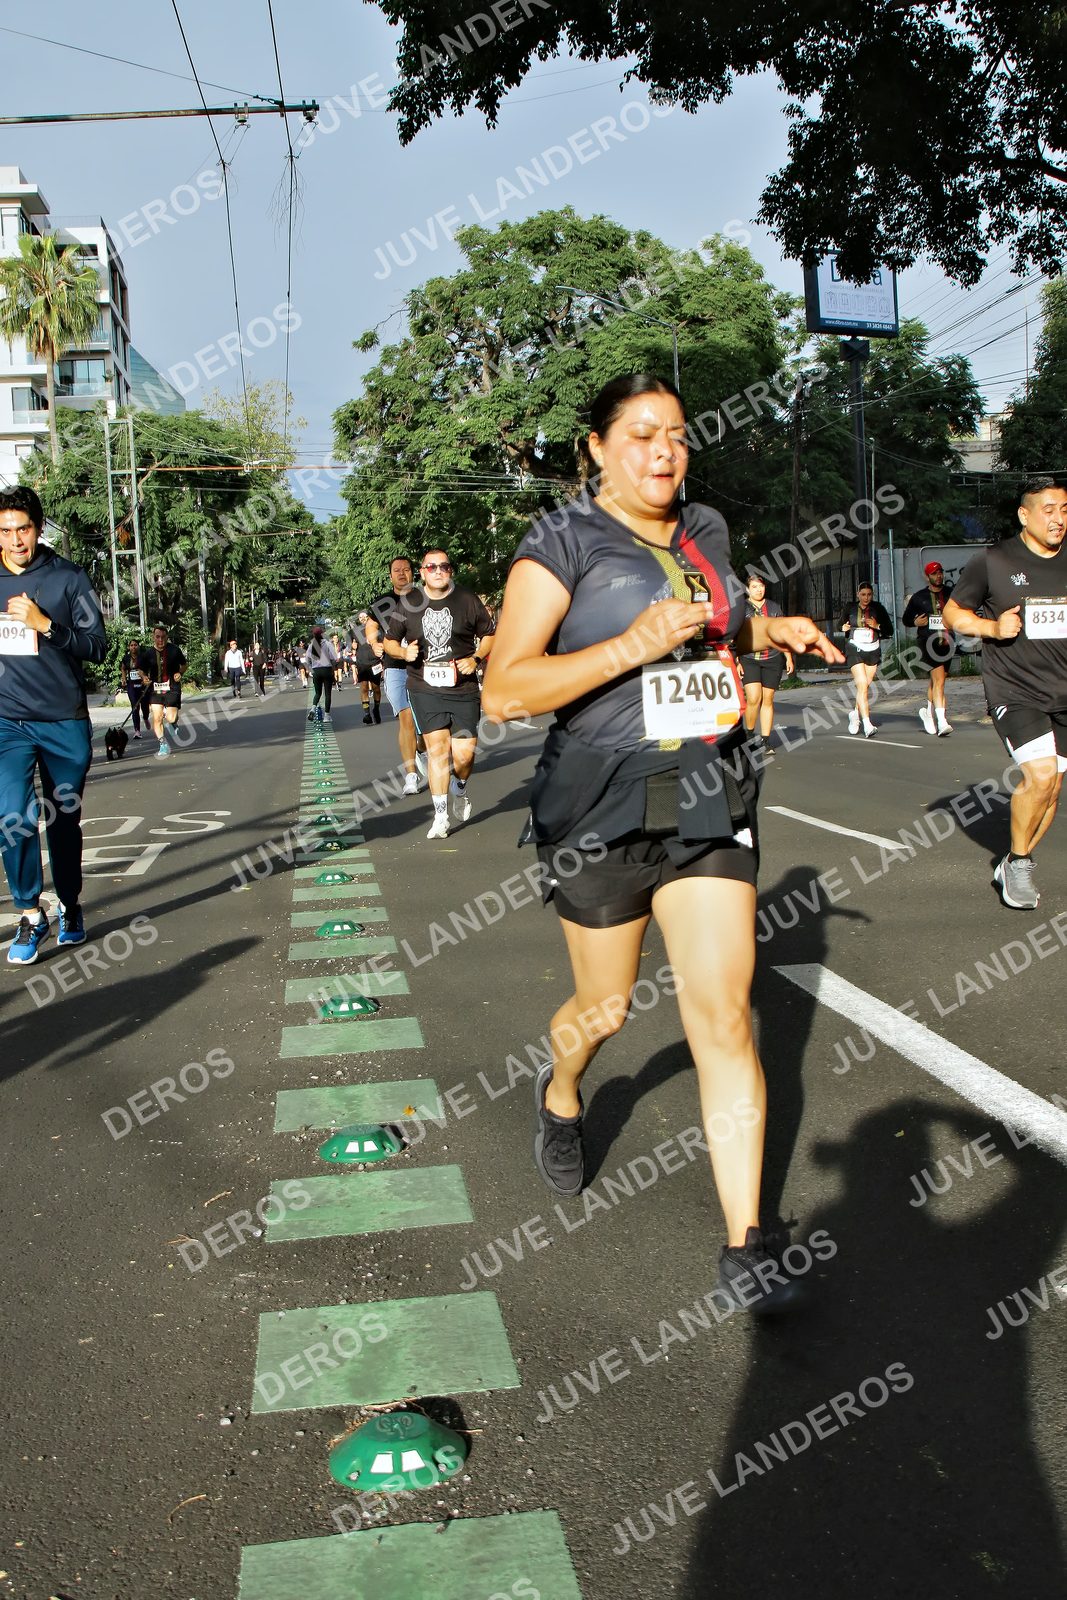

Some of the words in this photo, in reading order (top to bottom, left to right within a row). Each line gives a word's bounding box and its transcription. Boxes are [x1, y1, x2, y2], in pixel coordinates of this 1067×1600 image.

[1032, 610, 1065, 624] 8534
[0, 627, 26, 639] 094
[430, 670, 447, 679] 613
[649, 671, 732, 705] 12406
